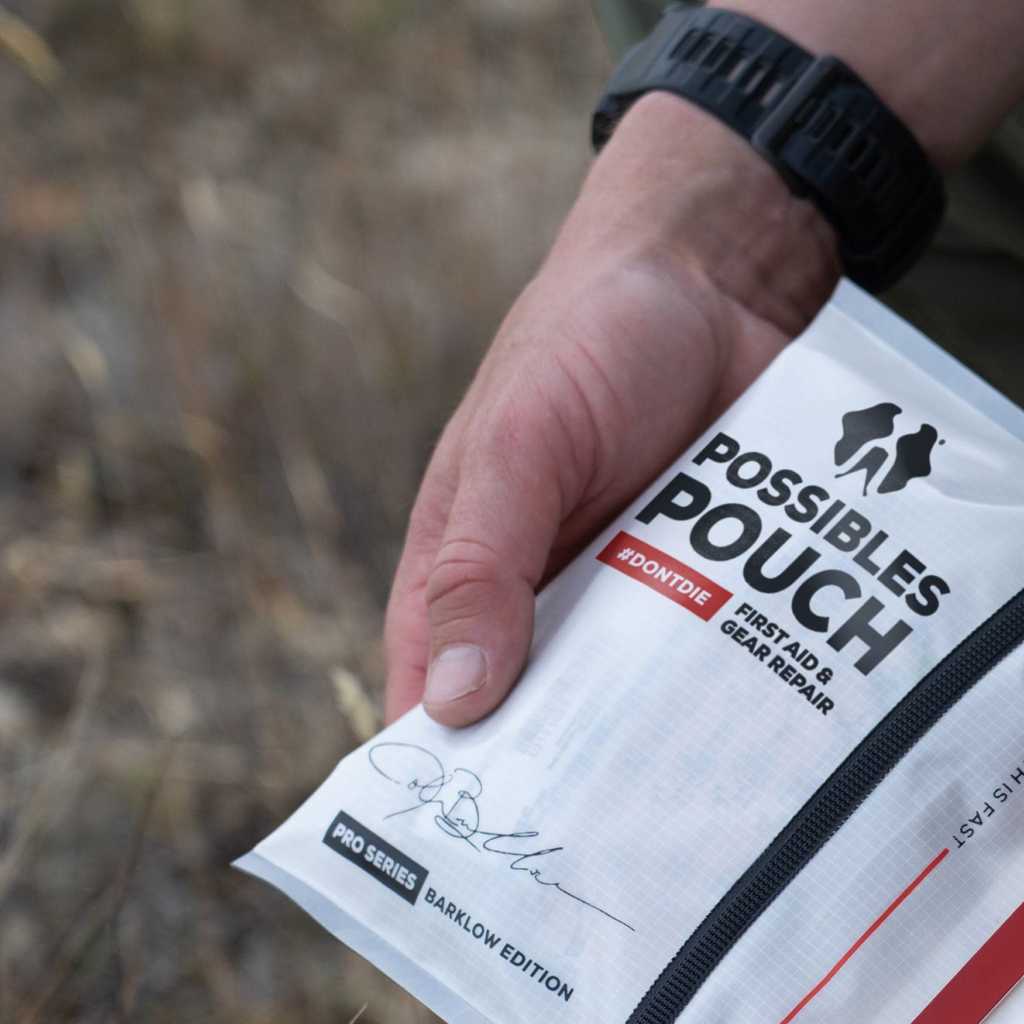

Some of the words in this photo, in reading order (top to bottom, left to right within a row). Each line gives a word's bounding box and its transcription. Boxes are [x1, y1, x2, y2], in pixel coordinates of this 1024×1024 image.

[692, 431, 951, 617] POSSIBLES
[615, 547, 712, 607] #DONTDIE
[635, 471, 914, 677] POUCH
[719, 619, 772, 663] GEAR
[767, 656, 835, 717] REPAIR
[734, 602, 789, 647] FIRST
[782, 639, 829, 674] AID
[817, 667, 834, 685] &
[953, 802, 996, 849] FAST
[992, 782, 1014, 802] IS
[332, 822, 366, 854] PRO
[364, 845, 418, 891] SERIES
[424, 887, 502, 950] BARKLOW
[499, 942, 575, 1002] EDITION
